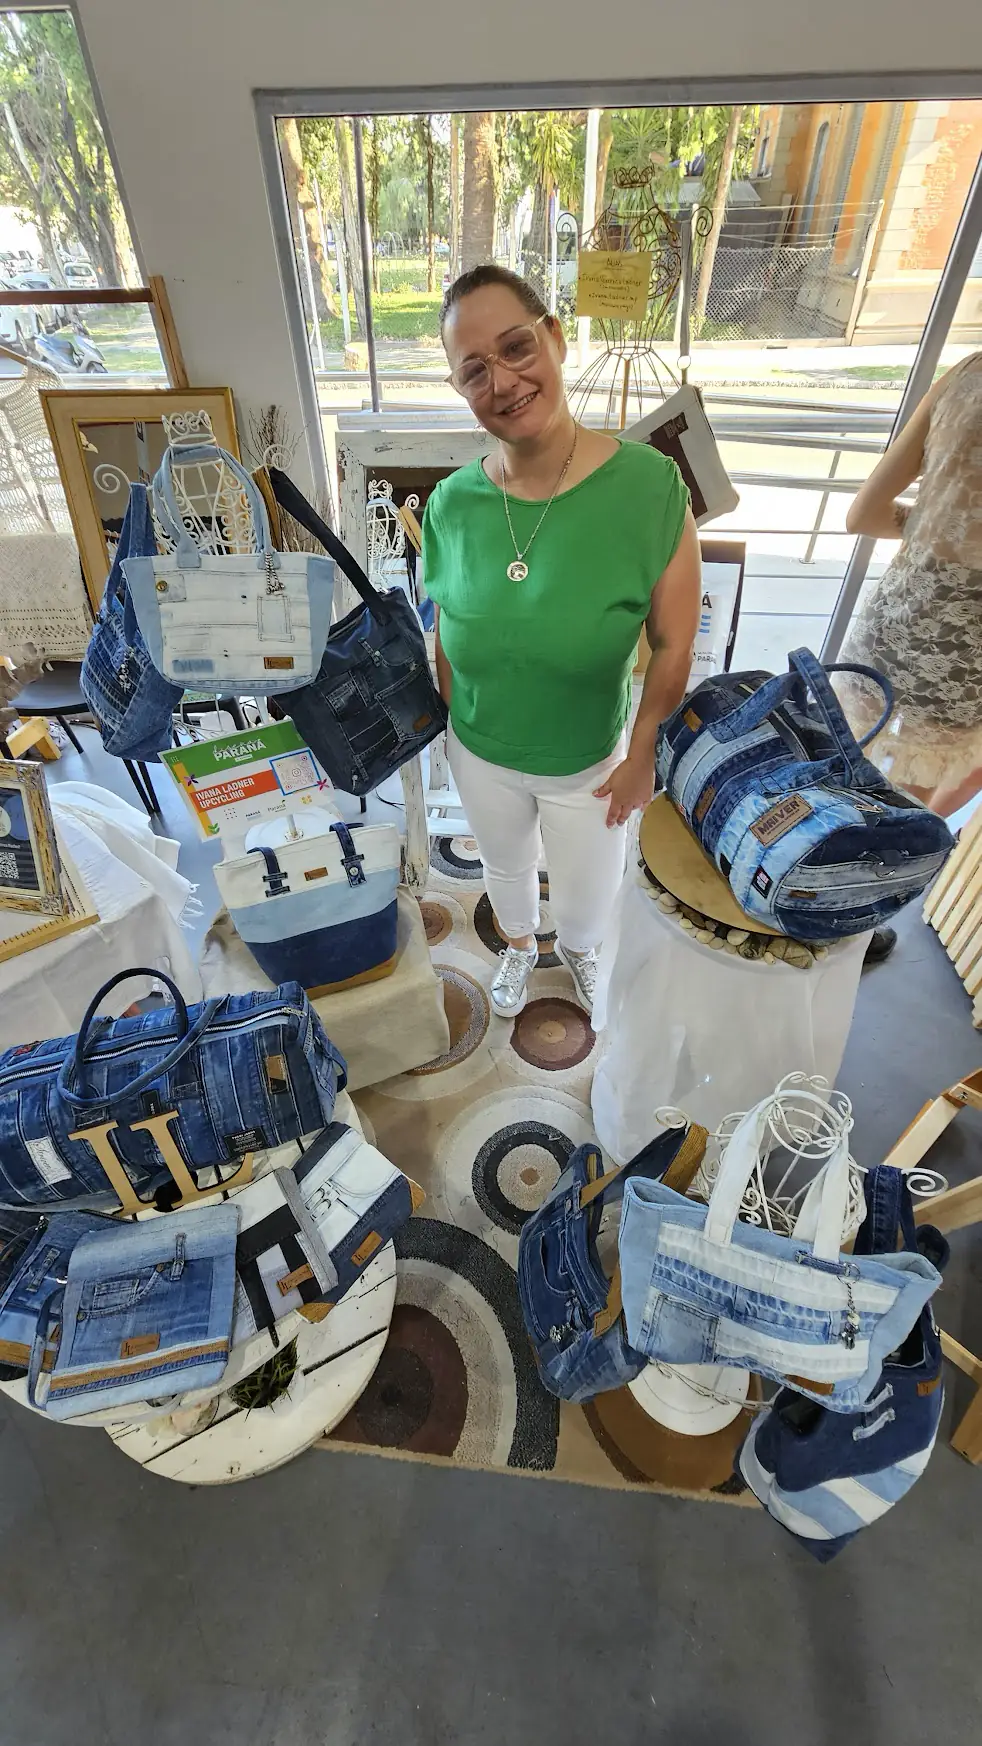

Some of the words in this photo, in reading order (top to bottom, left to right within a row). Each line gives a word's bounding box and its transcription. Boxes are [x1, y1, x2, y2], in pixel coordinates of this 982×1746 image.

[196, 788, 221, 802] IVANA
[222, 778, 255, 793] LADNER
[199, 790, 246, 809] UPCYCLING
